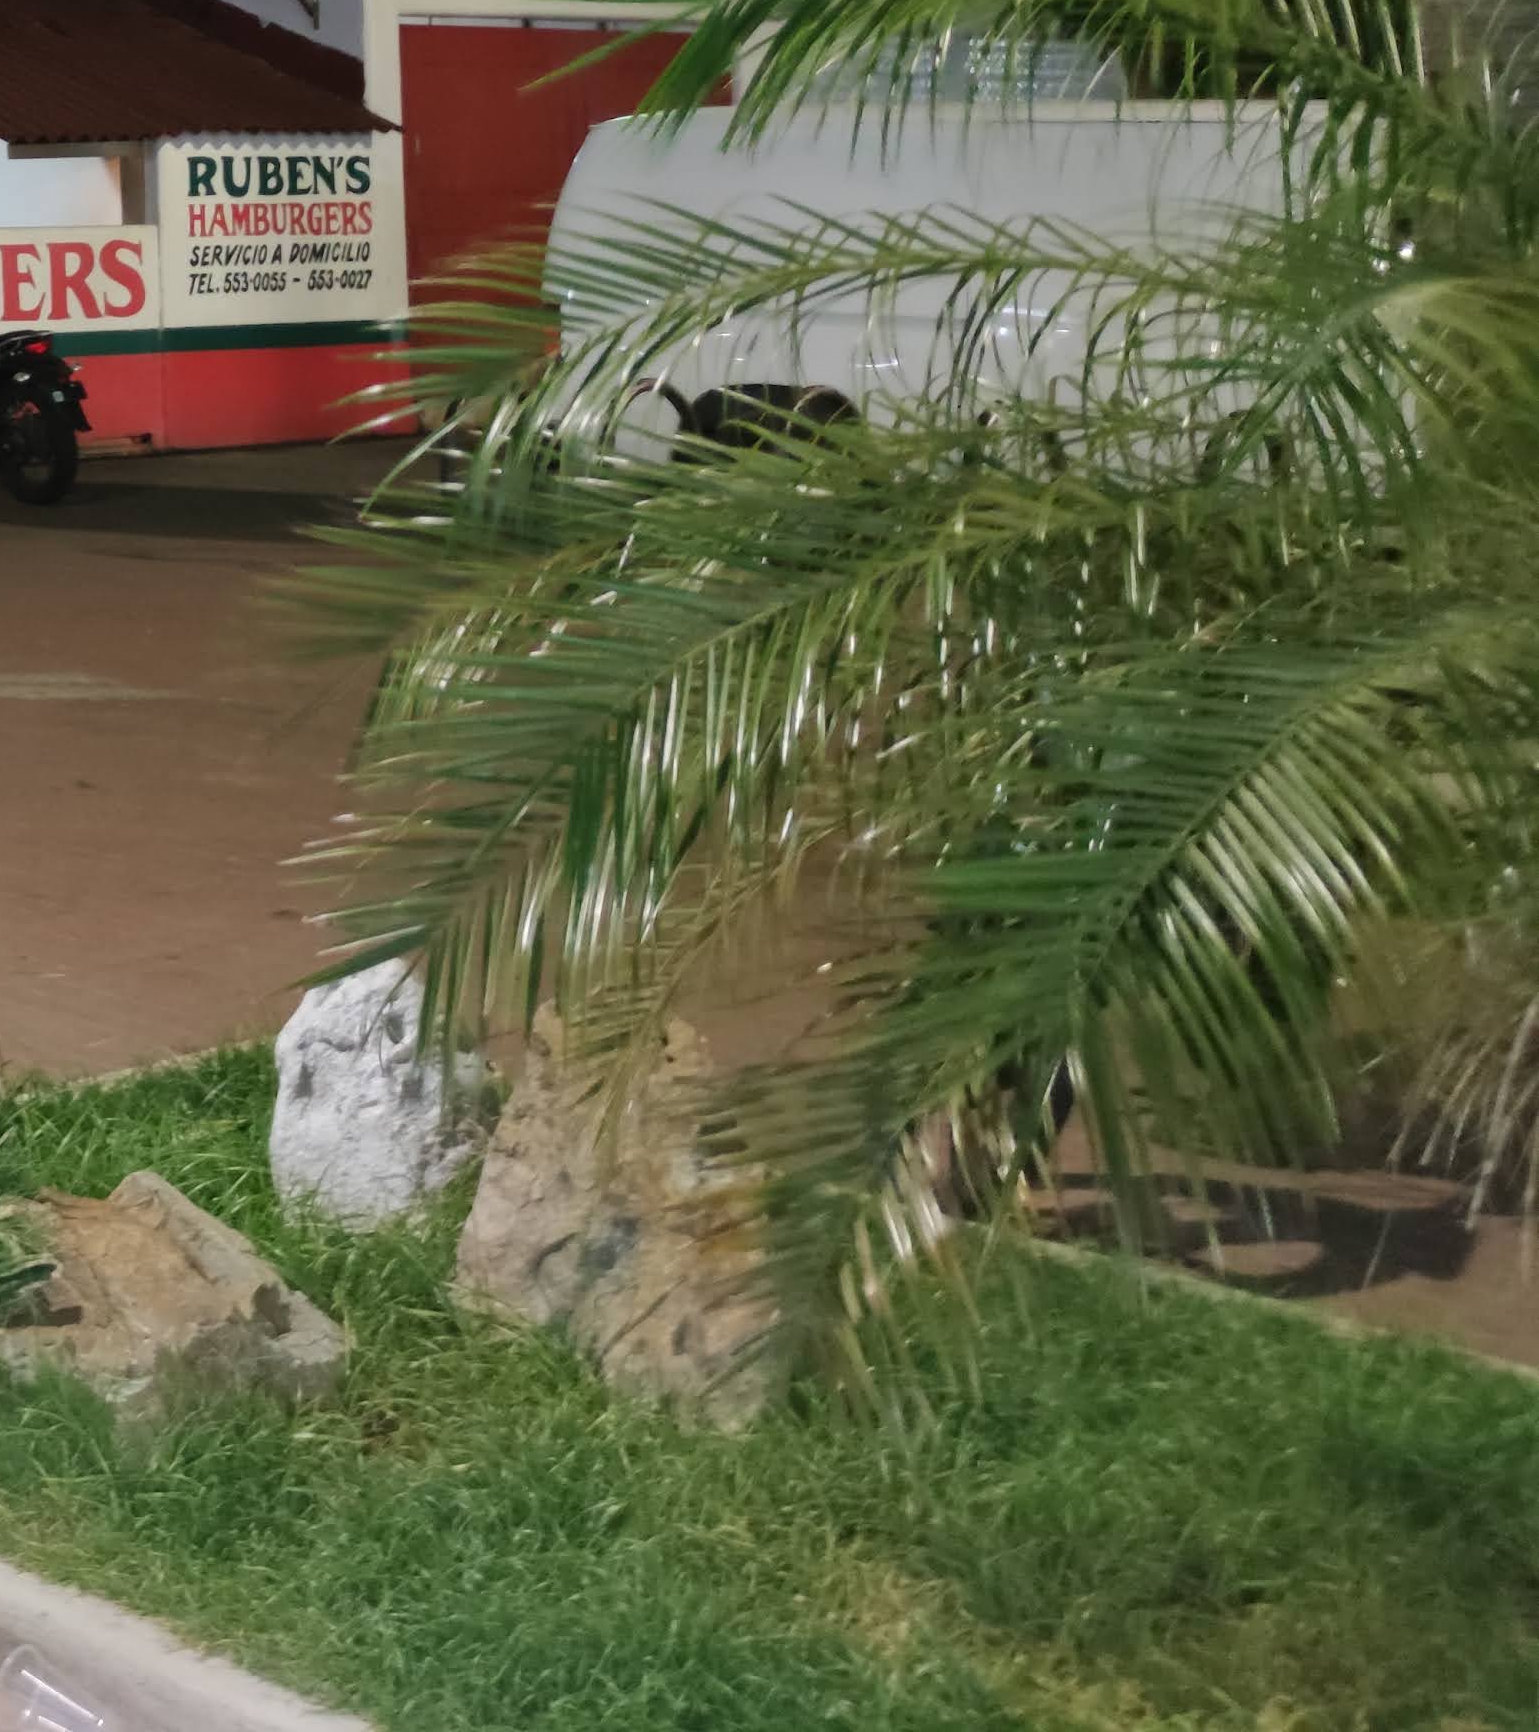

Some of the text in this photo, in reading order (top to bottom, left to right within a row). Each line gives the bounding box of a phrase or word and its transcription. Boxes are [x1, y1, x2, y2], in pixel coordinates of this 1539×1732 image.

[188, 155, 371, 197] RUBEN'S
[188, 201, 373, 237] HAMBURGERS
[189, 241, 370, 267] SERVICIO A DOMICILIO
